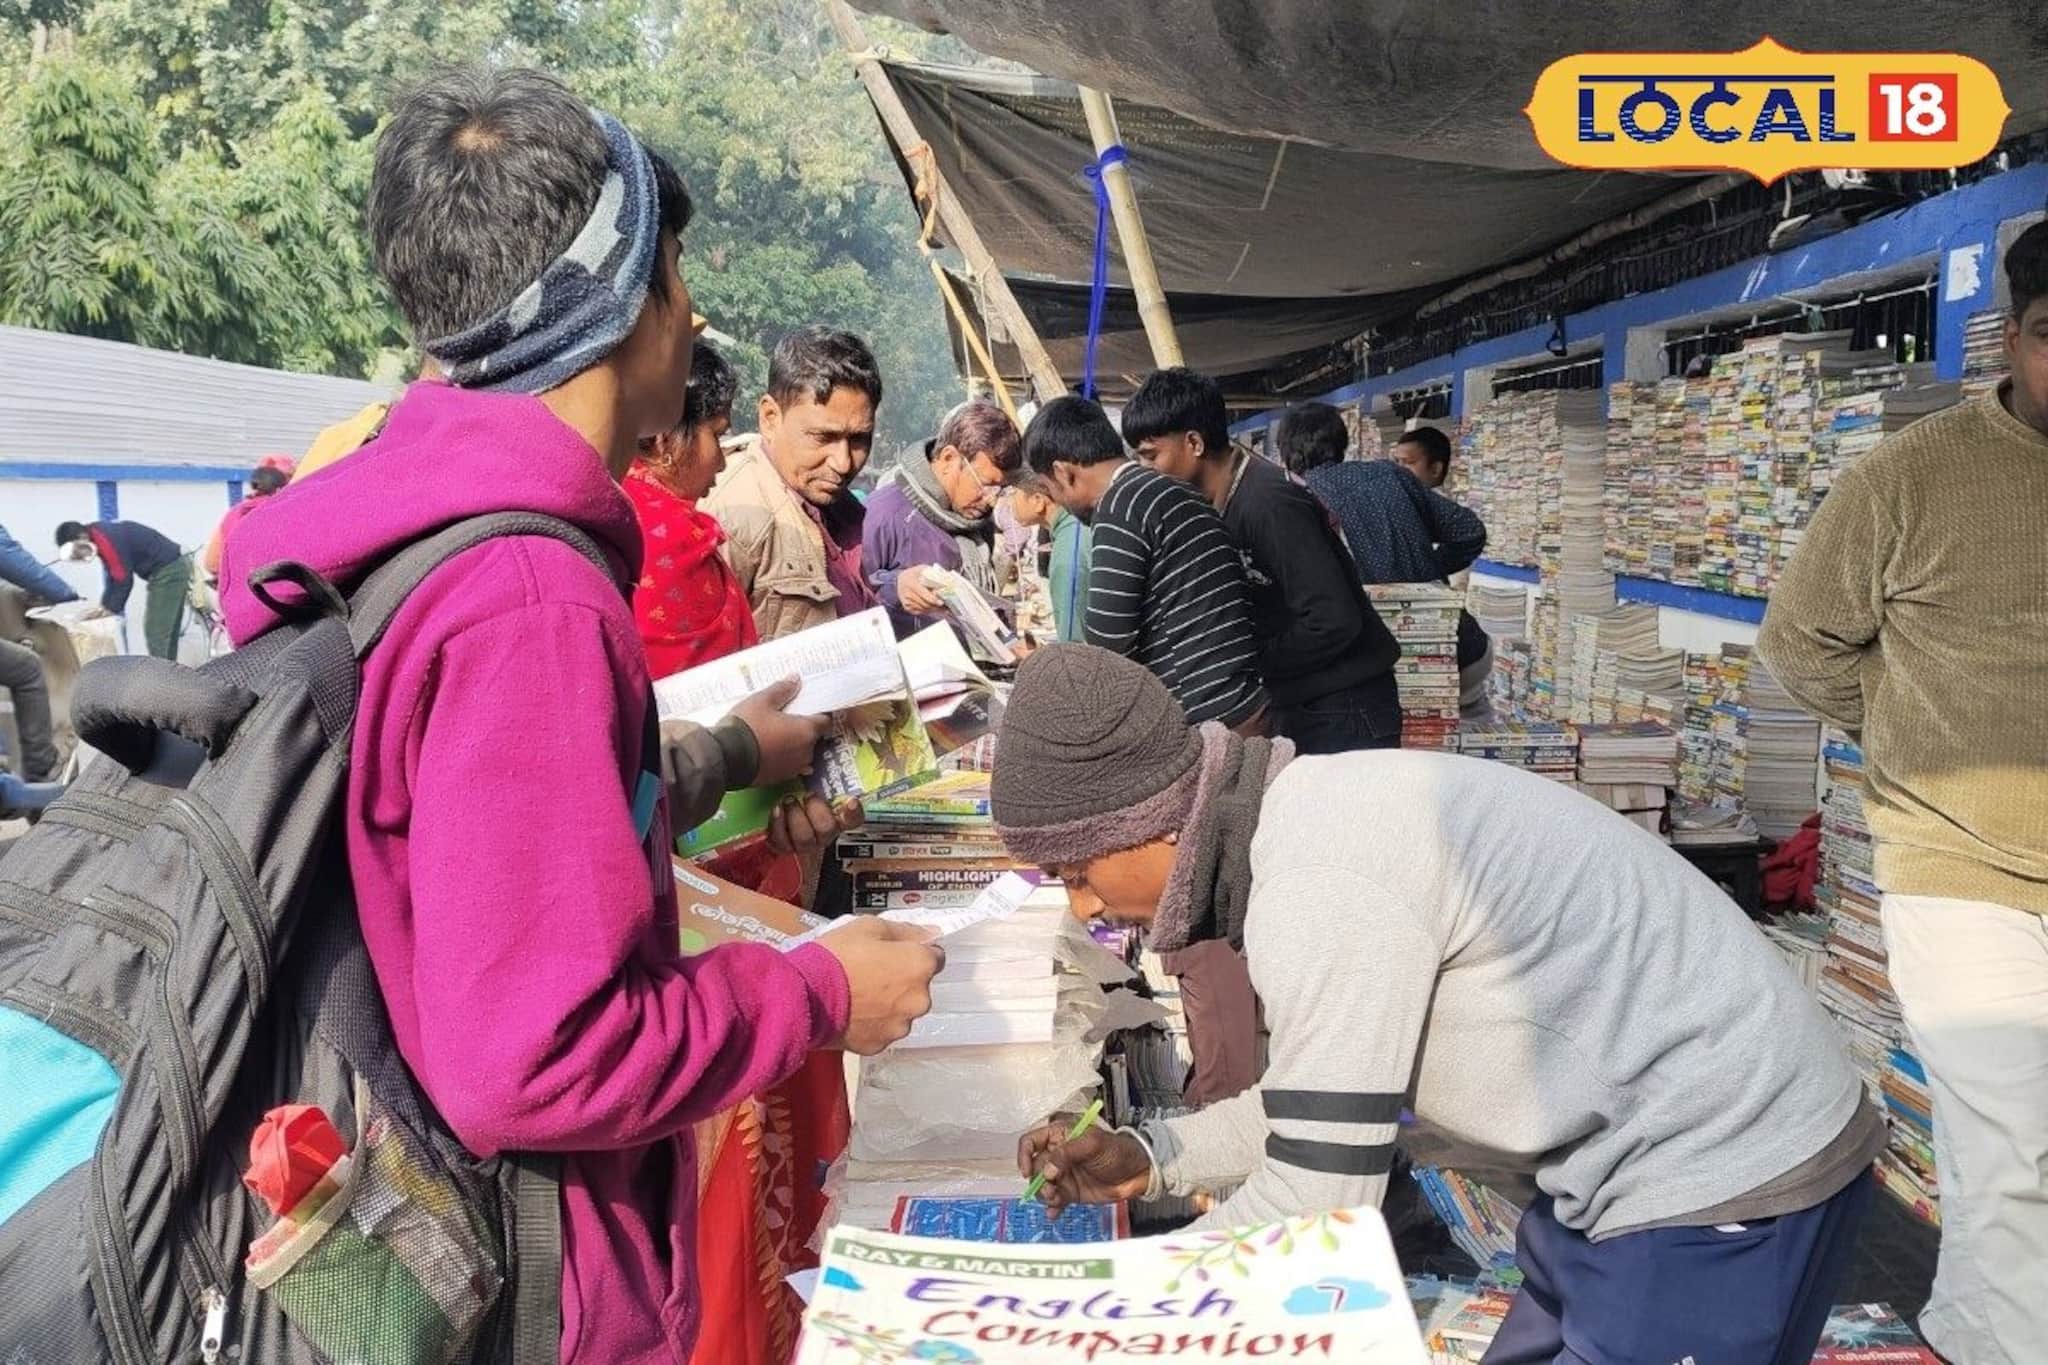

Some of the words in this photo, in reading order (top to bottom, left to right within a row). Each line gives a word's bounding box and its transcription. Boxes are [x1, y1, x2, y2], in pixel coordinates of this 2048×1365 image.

[918, 871, 1007, 883] HIGHLIGHT
[844, 1243, 911, 1267] RAY
[921, 1256, 948, 1270] &
[953, 1256, 1087, 1279] MARTIN
[906, 1278, 1237, 1320] English
[1317, 1285, 1345, 1312] 7
[921, 1311, 1334, 1362] Companion
